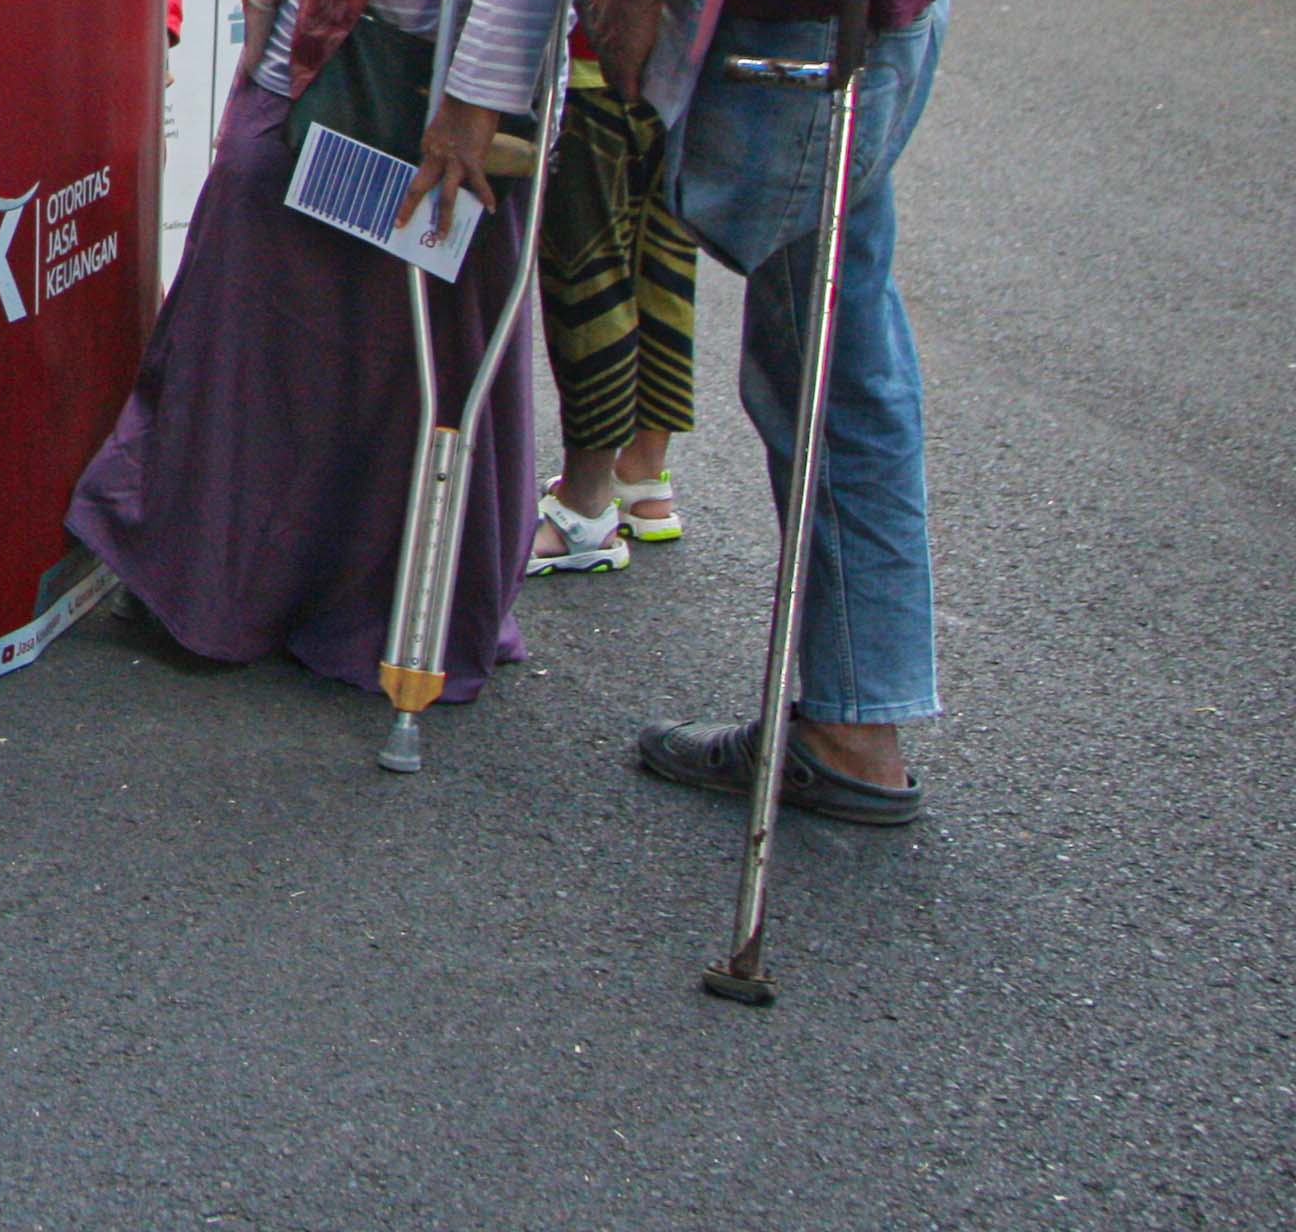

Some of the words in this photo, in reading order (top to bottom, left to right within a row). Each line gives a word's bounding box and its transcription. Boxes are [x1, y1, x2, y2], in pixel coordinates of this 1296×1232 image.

[45, 165, 111, 226] OTORITAS
[45, 220, 78, 264] JASA
[46, 231, 118, 301] KEUANGAN
